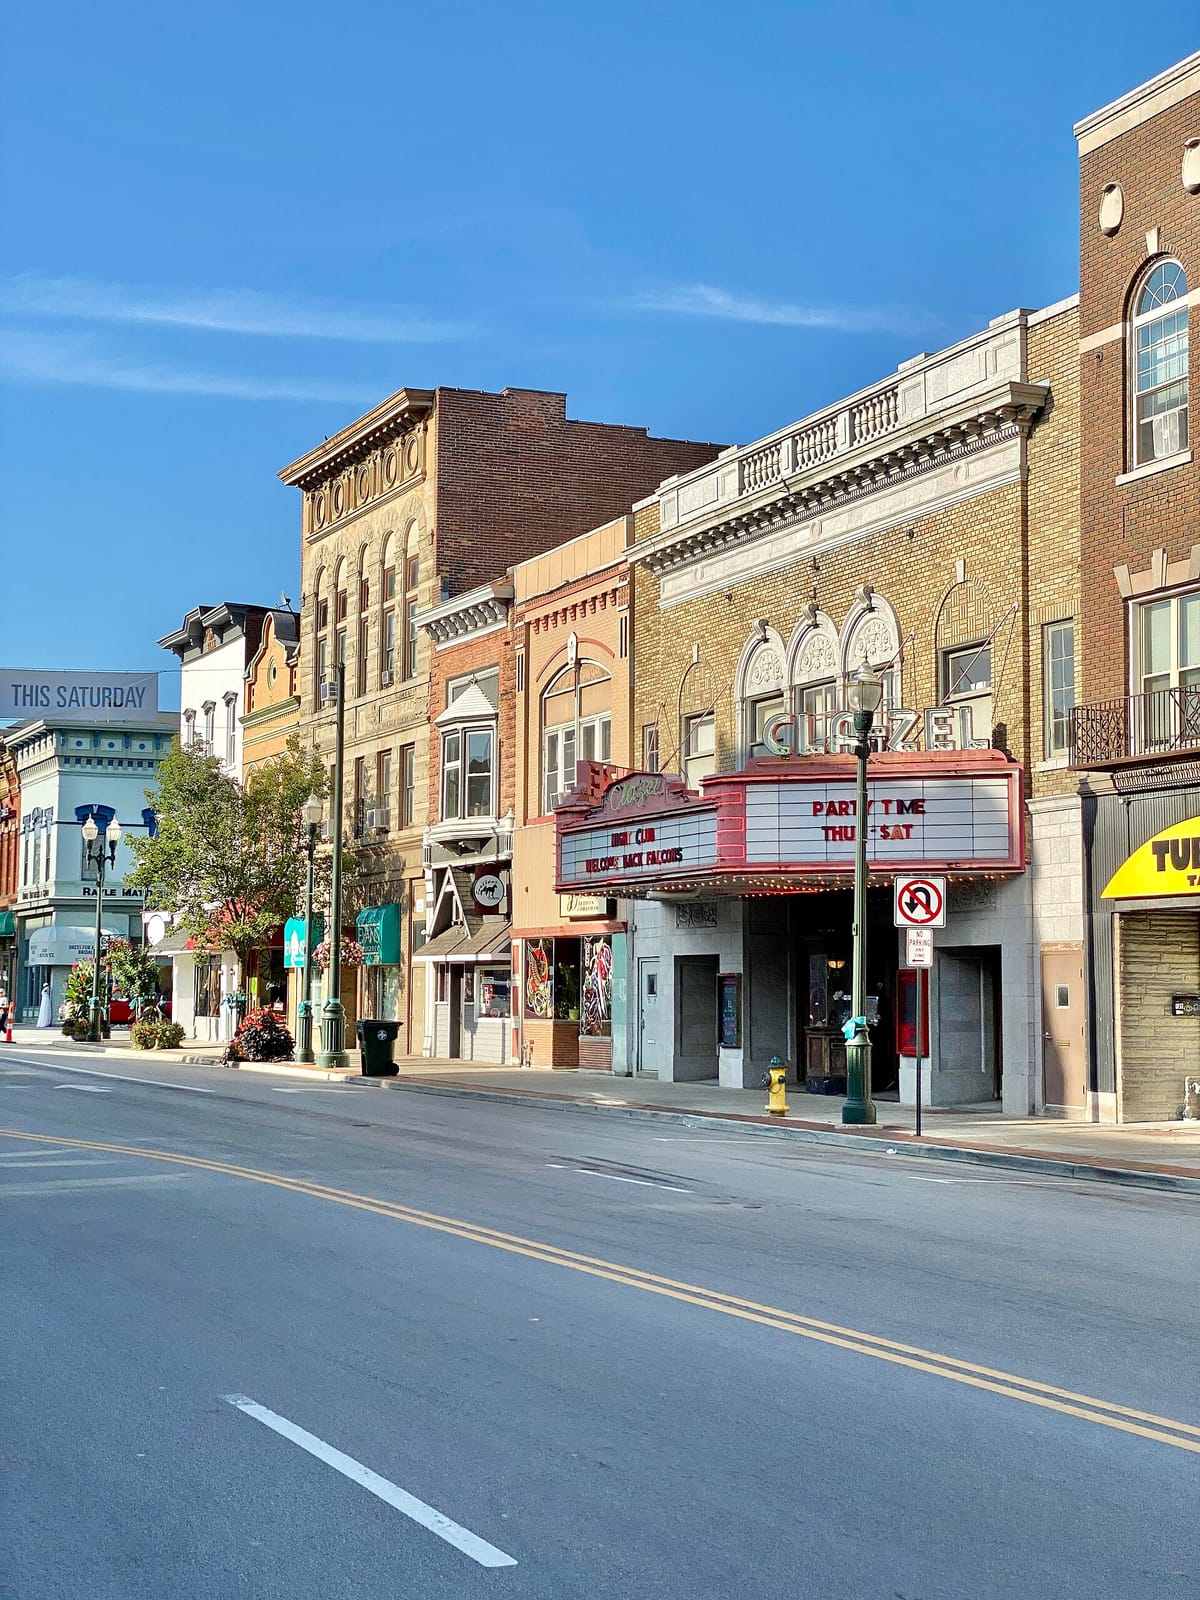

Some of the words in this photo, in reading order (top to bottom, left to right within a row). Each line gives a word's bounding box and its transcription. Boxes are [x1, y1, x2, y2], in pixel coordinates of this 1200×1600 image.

[11, 684, 50, 707] THIS
[56, 685, 146, 708] SATURDAY
[762, 705, 990, 756] CLAZEL
[881, 799, 926, 815] TIME
[585, 855, 619, 872] WELCOME
[623, 852, 643, 868] BACK
[646, 847, 683, 865] FALCONS
[82, 887, 117, 897] RALE
